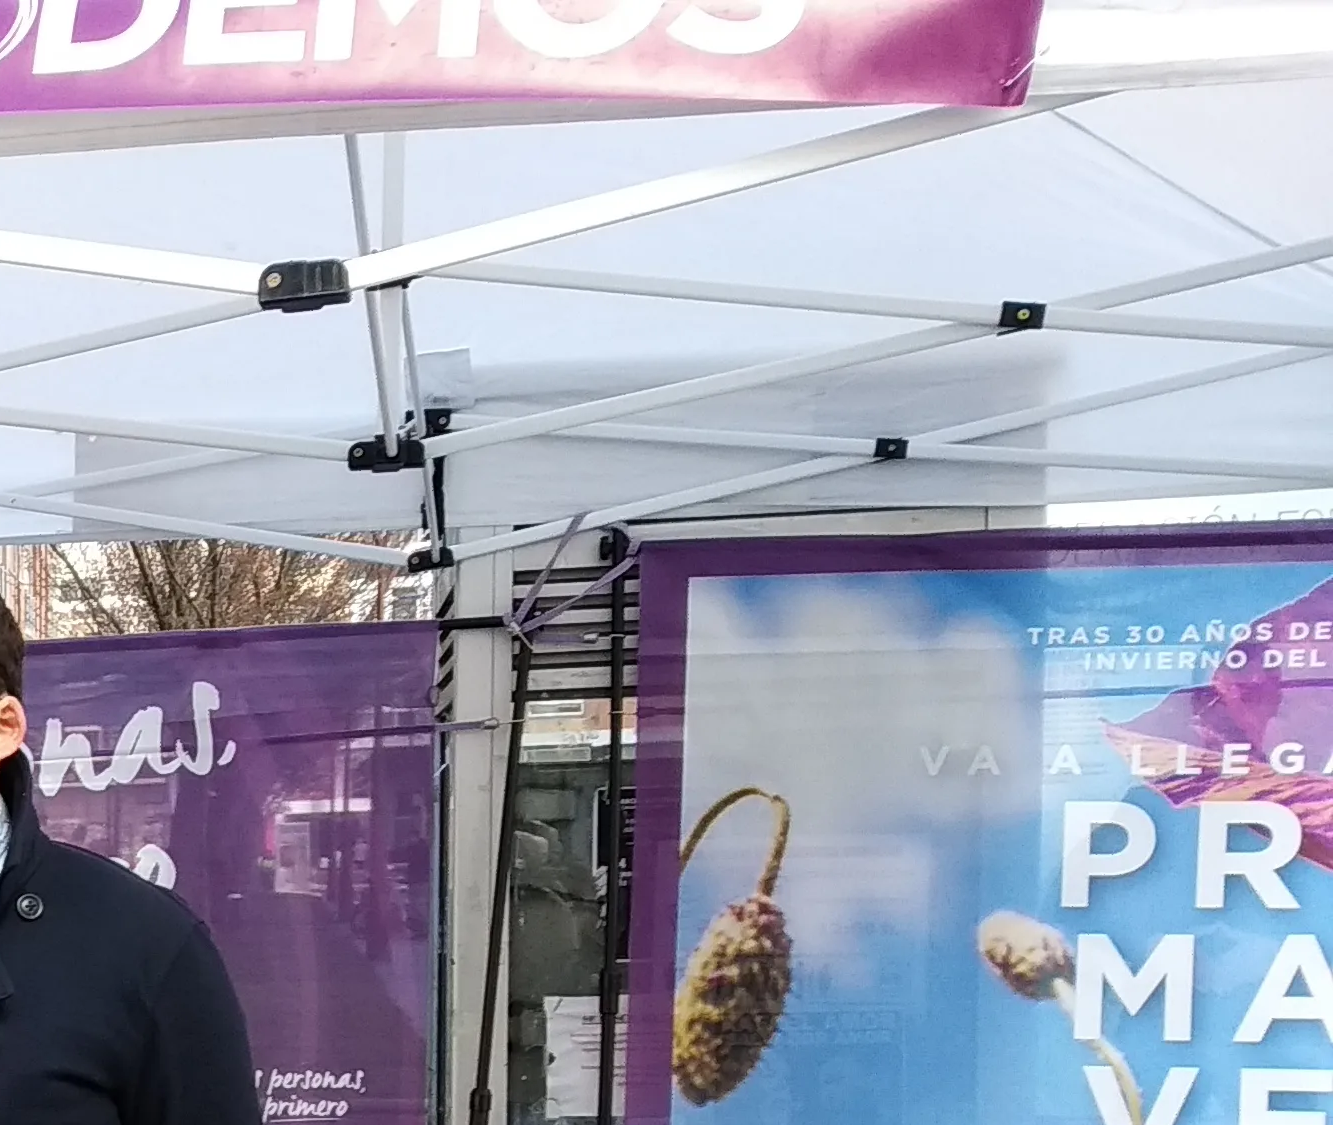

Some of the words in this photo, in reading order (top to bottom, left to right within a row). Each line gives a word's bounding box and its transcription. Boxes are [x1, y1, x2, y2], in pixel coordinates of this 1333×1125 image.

[1028, 625, 1111, 646] TRAS
[1125, 624, 1165, 644] 30
[1179, 619, 1273, 643] AÑOS
[1084, 649, 1248, 671] INVIERNO
[1264, 648, 1326, 668] DEL
[1131, 742, 1333, 776] LLEG
[1073, 933, 1333, 1044] MA
[265, 1068, 367, 1095] personas,
[261, 1094, 350, 1123] primero
